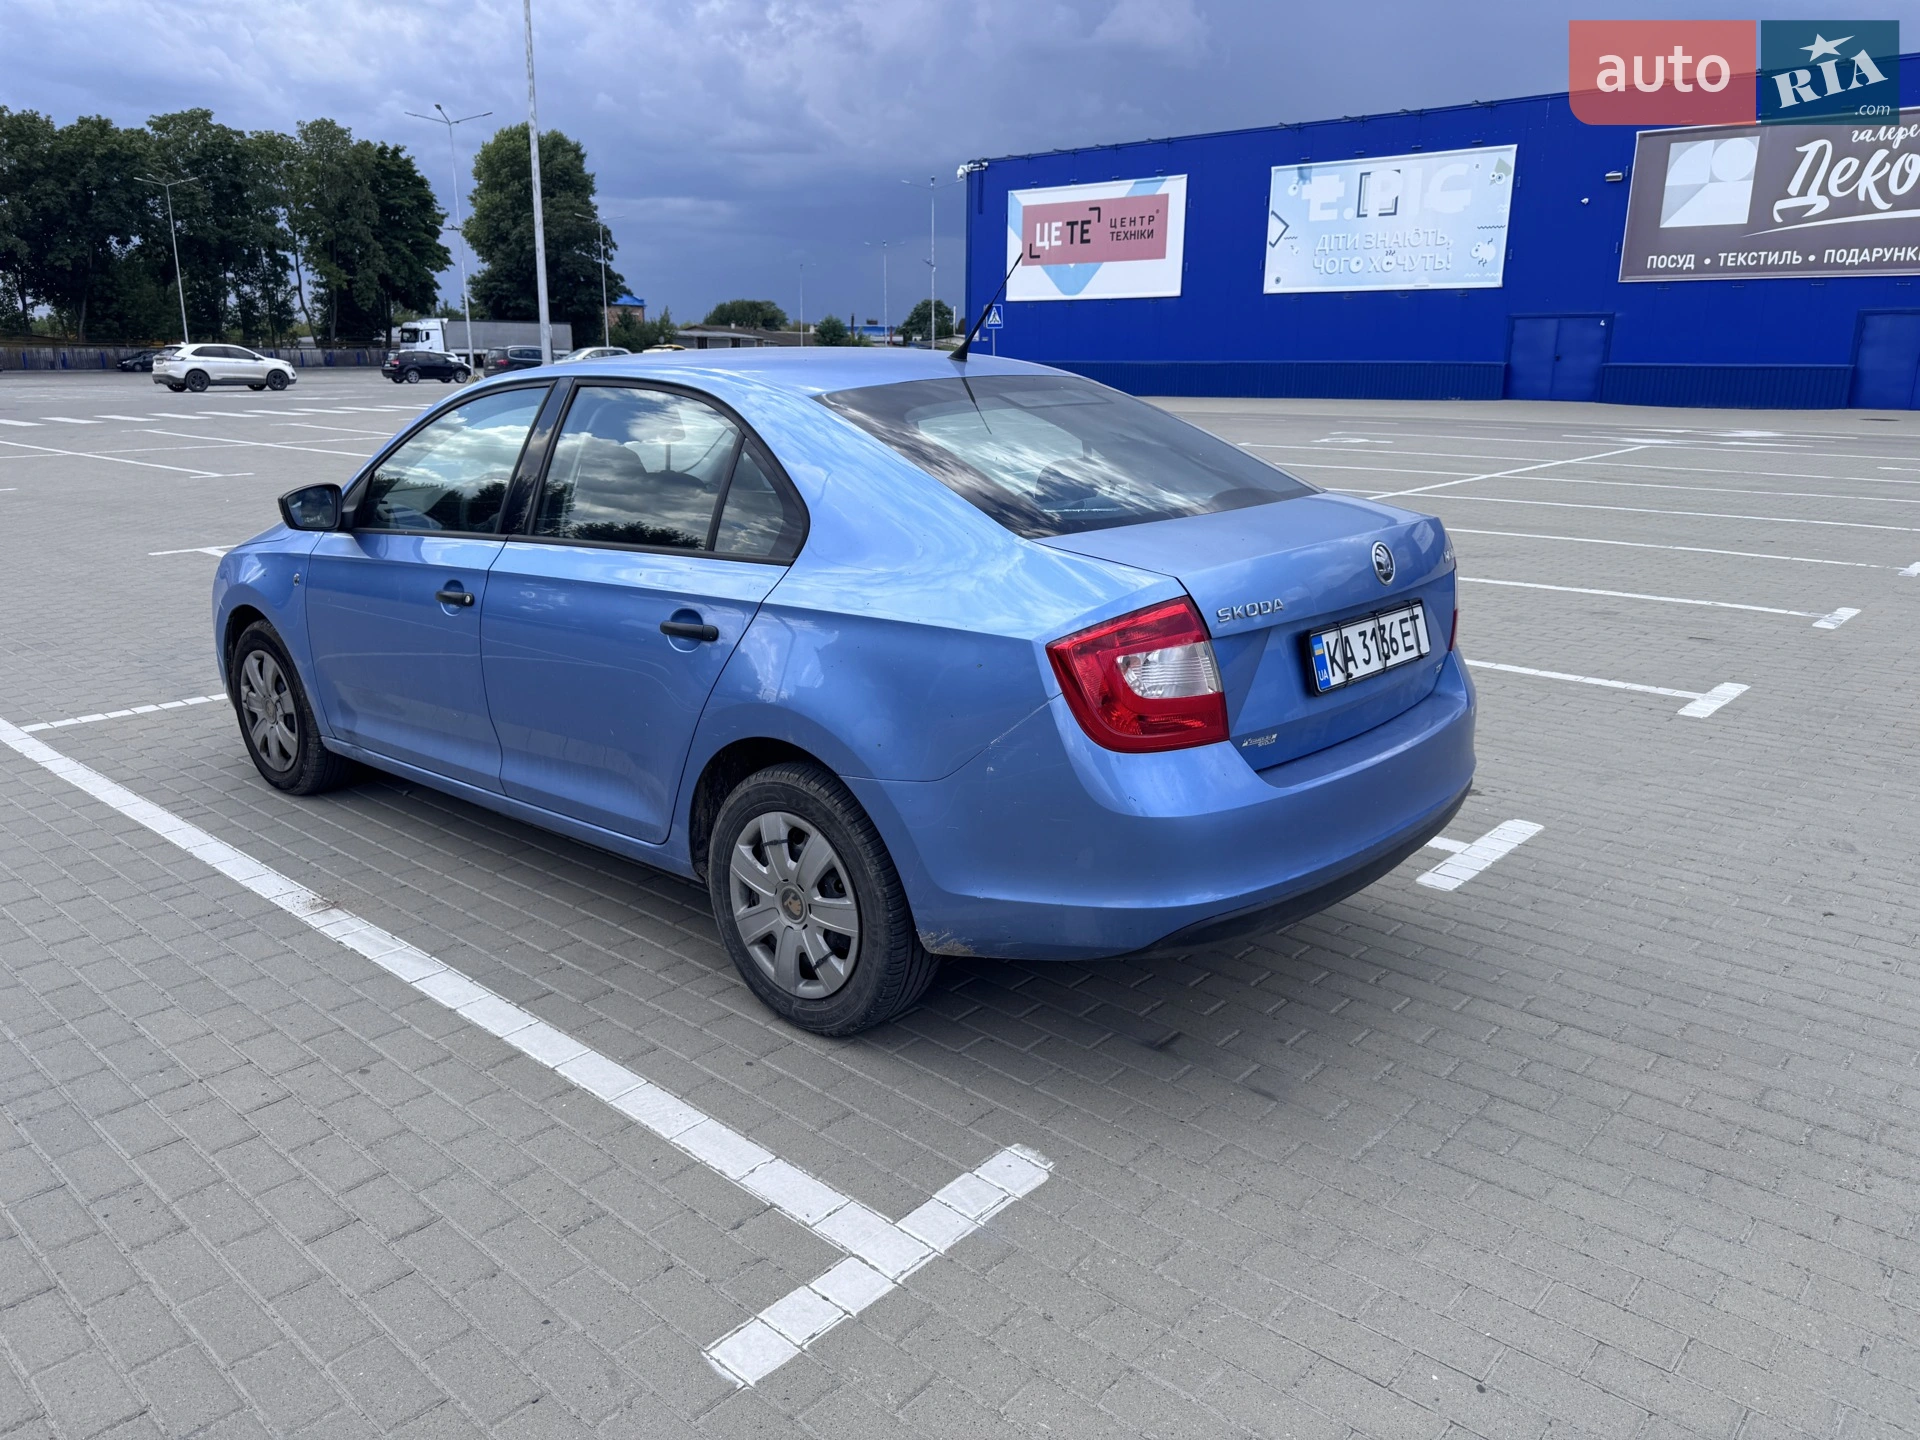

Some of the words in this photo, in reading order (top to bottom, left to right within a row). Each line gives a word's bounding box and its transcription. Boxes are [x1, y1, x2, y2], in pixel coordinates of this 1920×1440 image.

[1110, 215, 1155, 229] ЦЕНТР
[1110, 228, 1154, 242] ТЕХНІКИ
[1315, 233, 1360, 255] ДІТИ
[1313, 256, 1363, 275] ЧОГО
[1367, 252, 1453, 273] ХОЧУТЬ!
[1647, 254, 1695, 270] ПОСУД
[1718, 250, 1802, 267] ТЕКСТИЛЬ
[1824, 246, 1920, 266] ПОДАРУНК
[1318, 671, 1329, 681] UA
